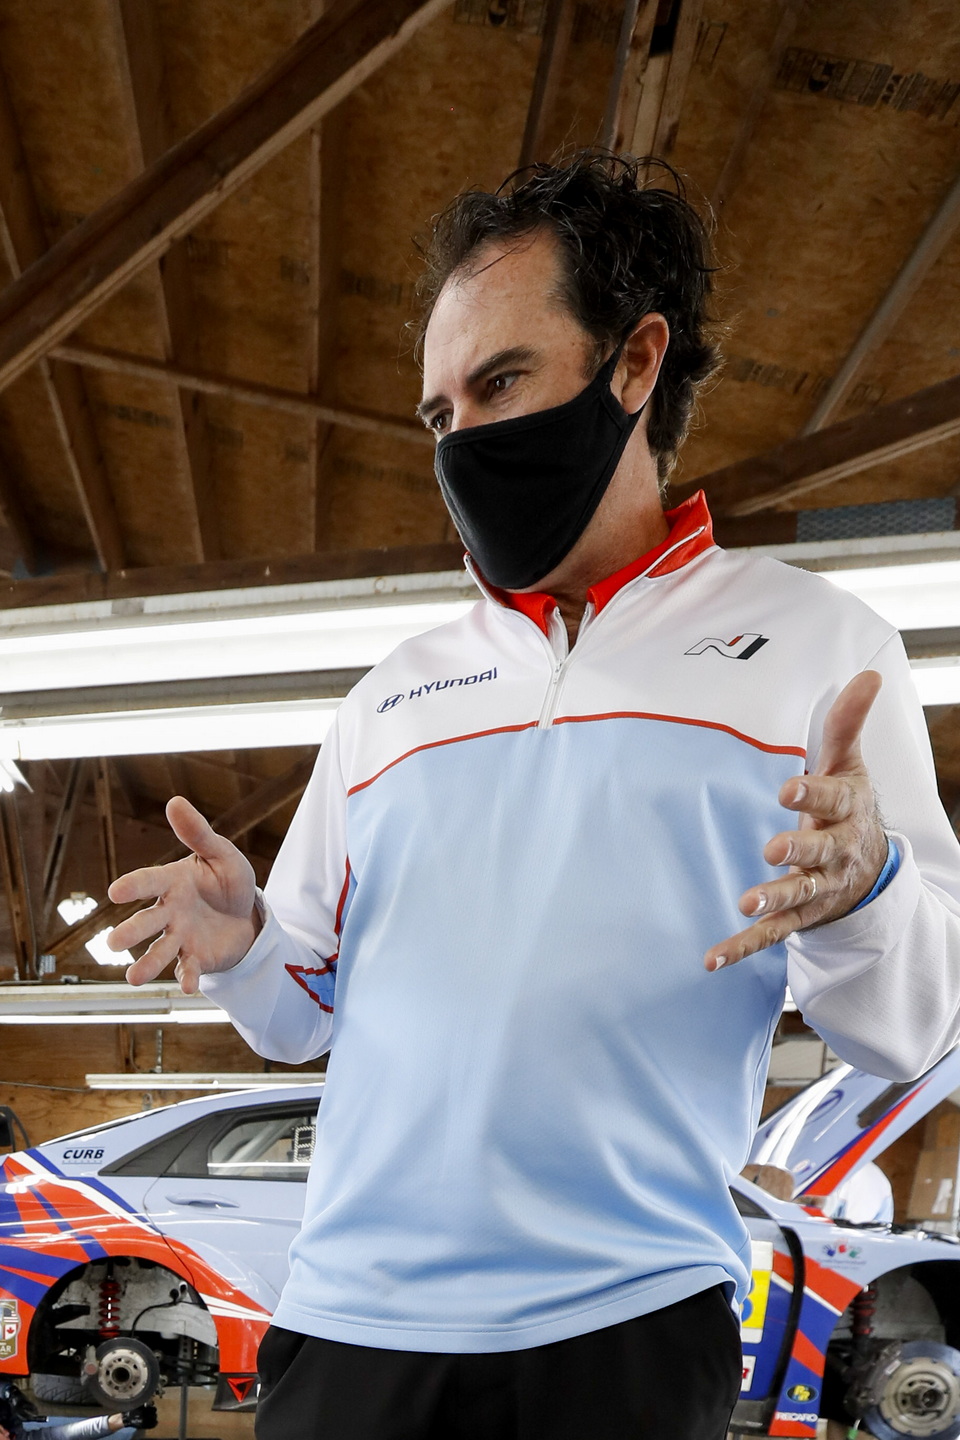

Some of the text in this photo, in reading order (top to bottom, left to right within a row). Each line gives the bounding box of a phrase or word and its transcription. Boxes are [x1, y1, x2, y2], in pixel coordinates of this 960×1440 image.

[408, 666, 498, 700] HYUNDAI
[63, 1149, 105, 1159] CURB
[775, 1412, 818, 1422] RECARO
